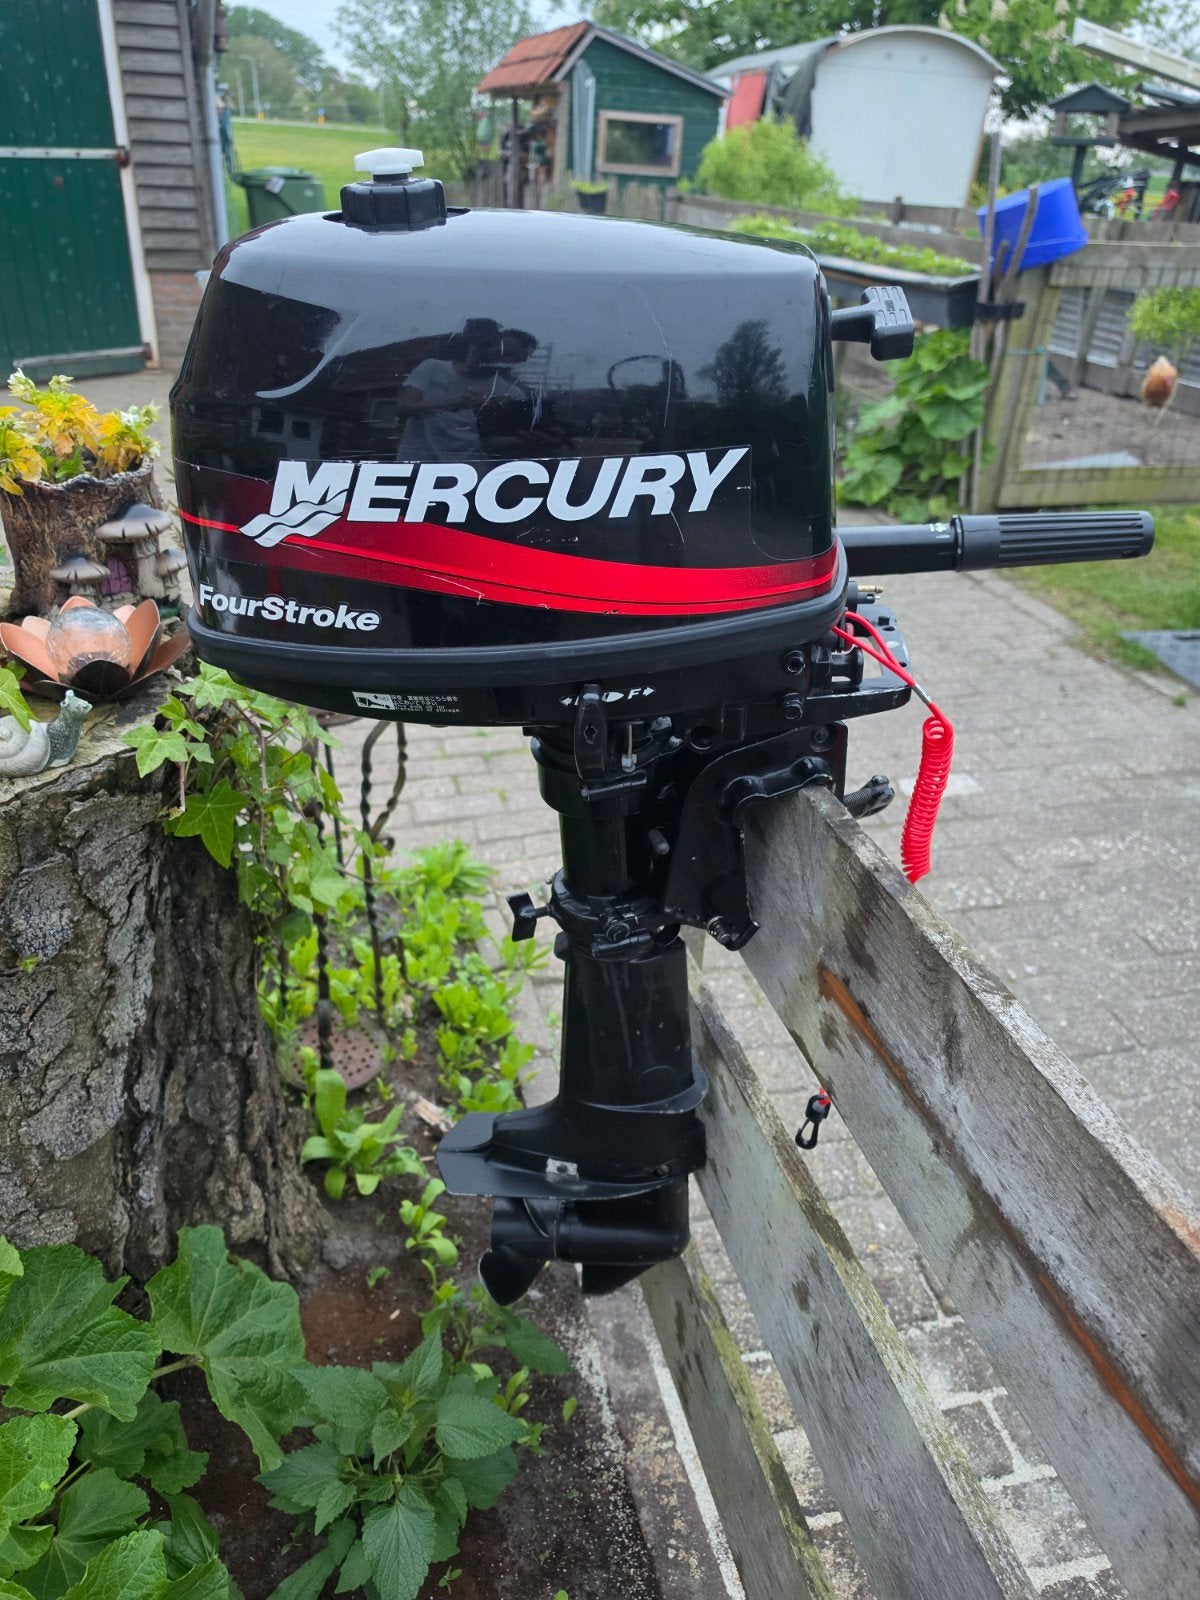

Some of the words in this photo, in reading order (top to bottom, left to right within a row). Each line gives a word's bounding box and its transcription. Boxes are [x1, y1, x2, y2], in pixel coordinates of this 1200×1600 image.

[239, 447, 750, 547] MERCURY
[199, 582, 381, 632] FourStroke
[627, 688, 642, 700] F
